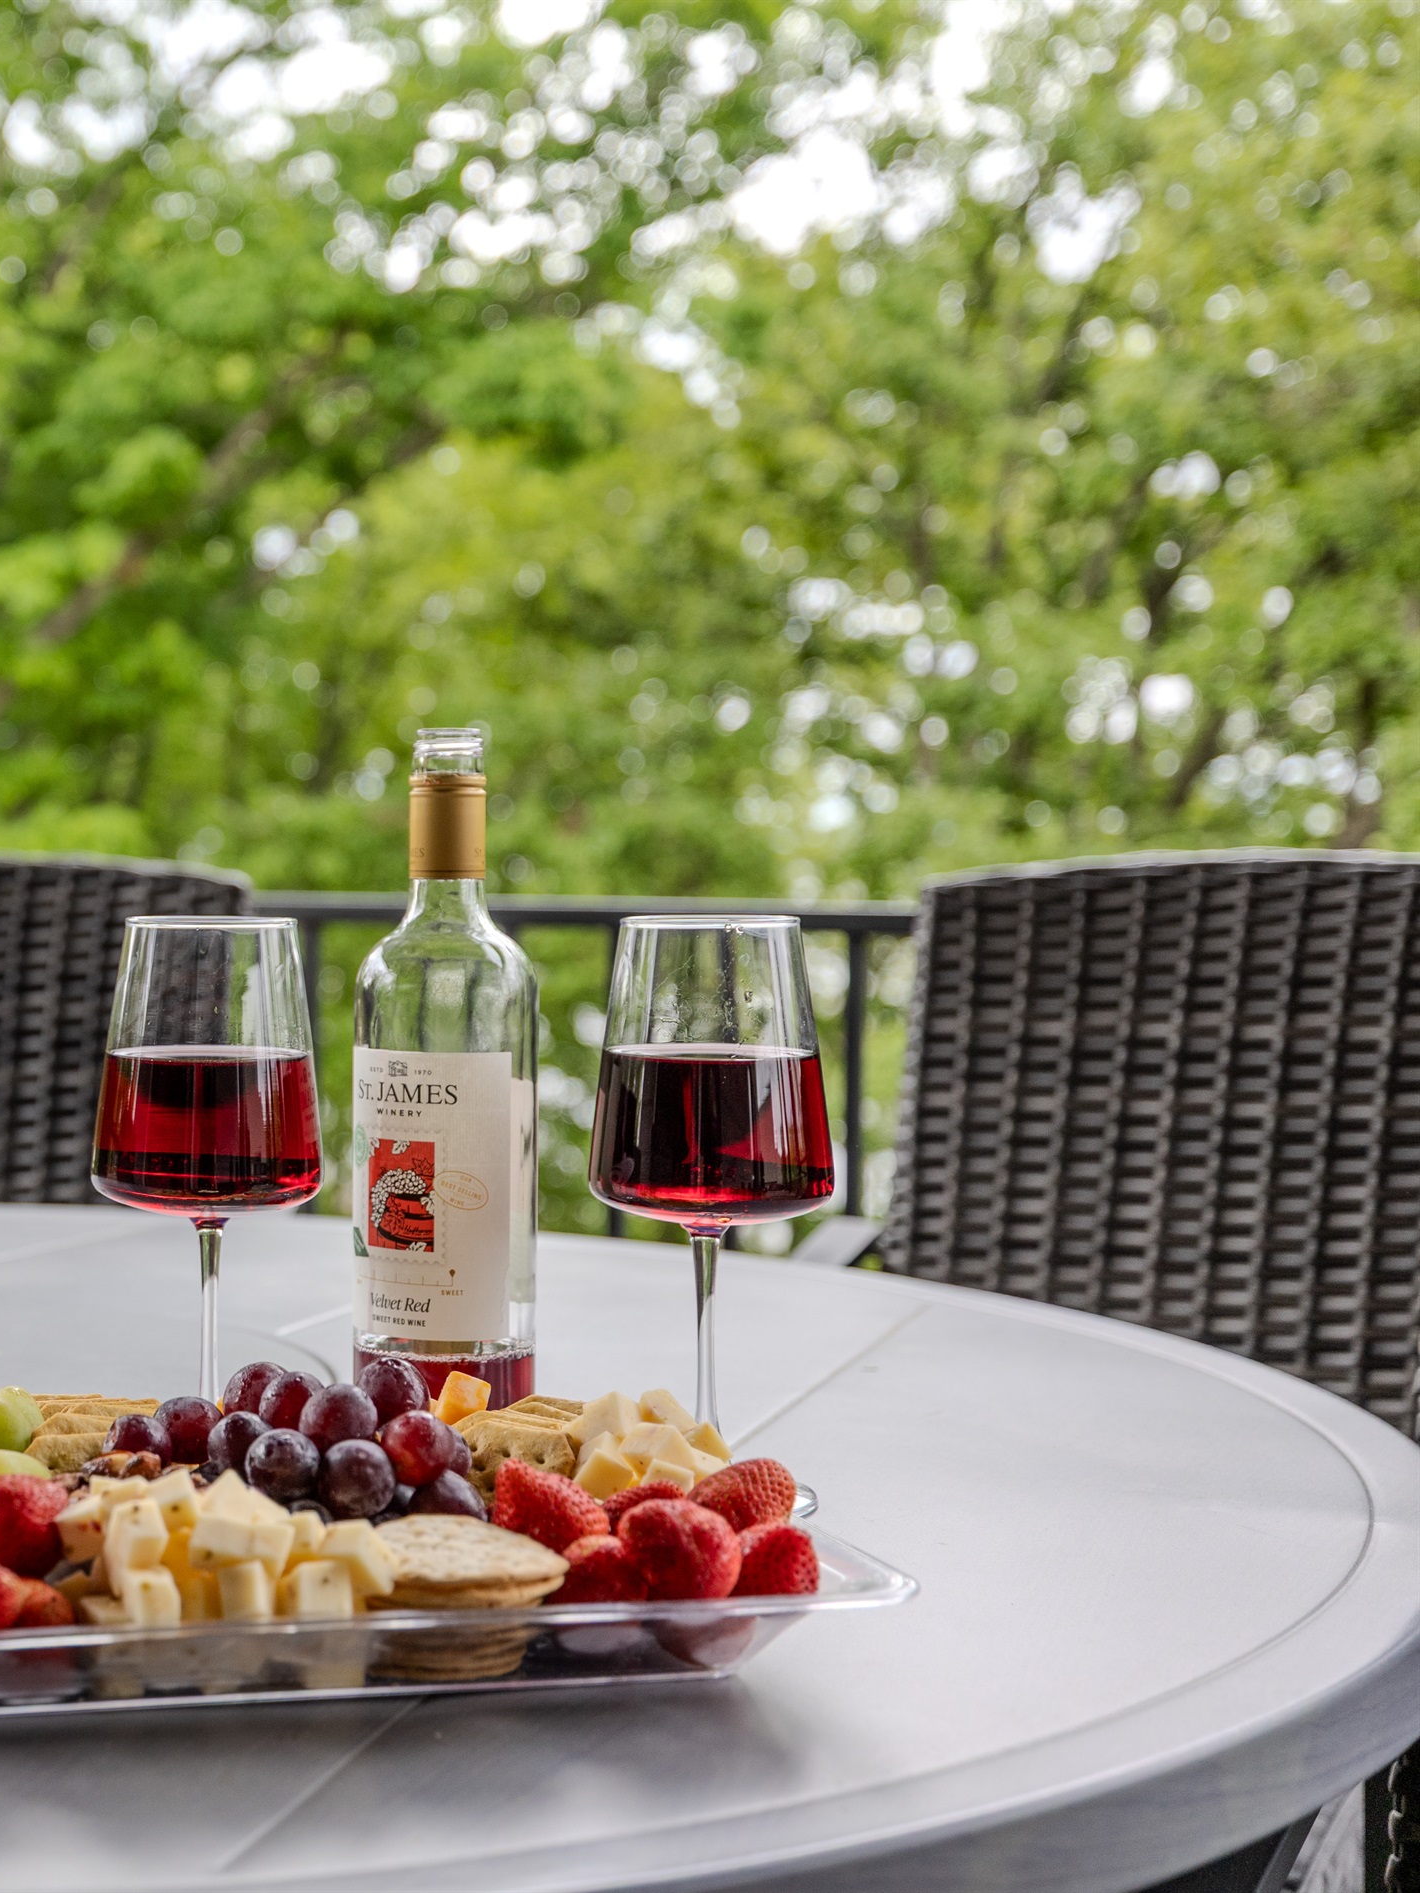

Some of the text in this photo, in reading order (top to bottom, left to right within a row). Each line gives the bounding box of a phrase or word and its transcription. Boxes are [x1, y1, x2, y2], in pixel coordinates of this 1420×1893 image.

[377, 1082, 458, 1105] JAMES
[377, 1108, 422, 1117] WINERY
[440, 1180, 482, 1200] BEST SELLING
[449, 1196, 465, 1207] WINE
[370, 1292, 431, 1313] Velvet Red
[372, 1314, 426, 1327] SWEET RED WINE
